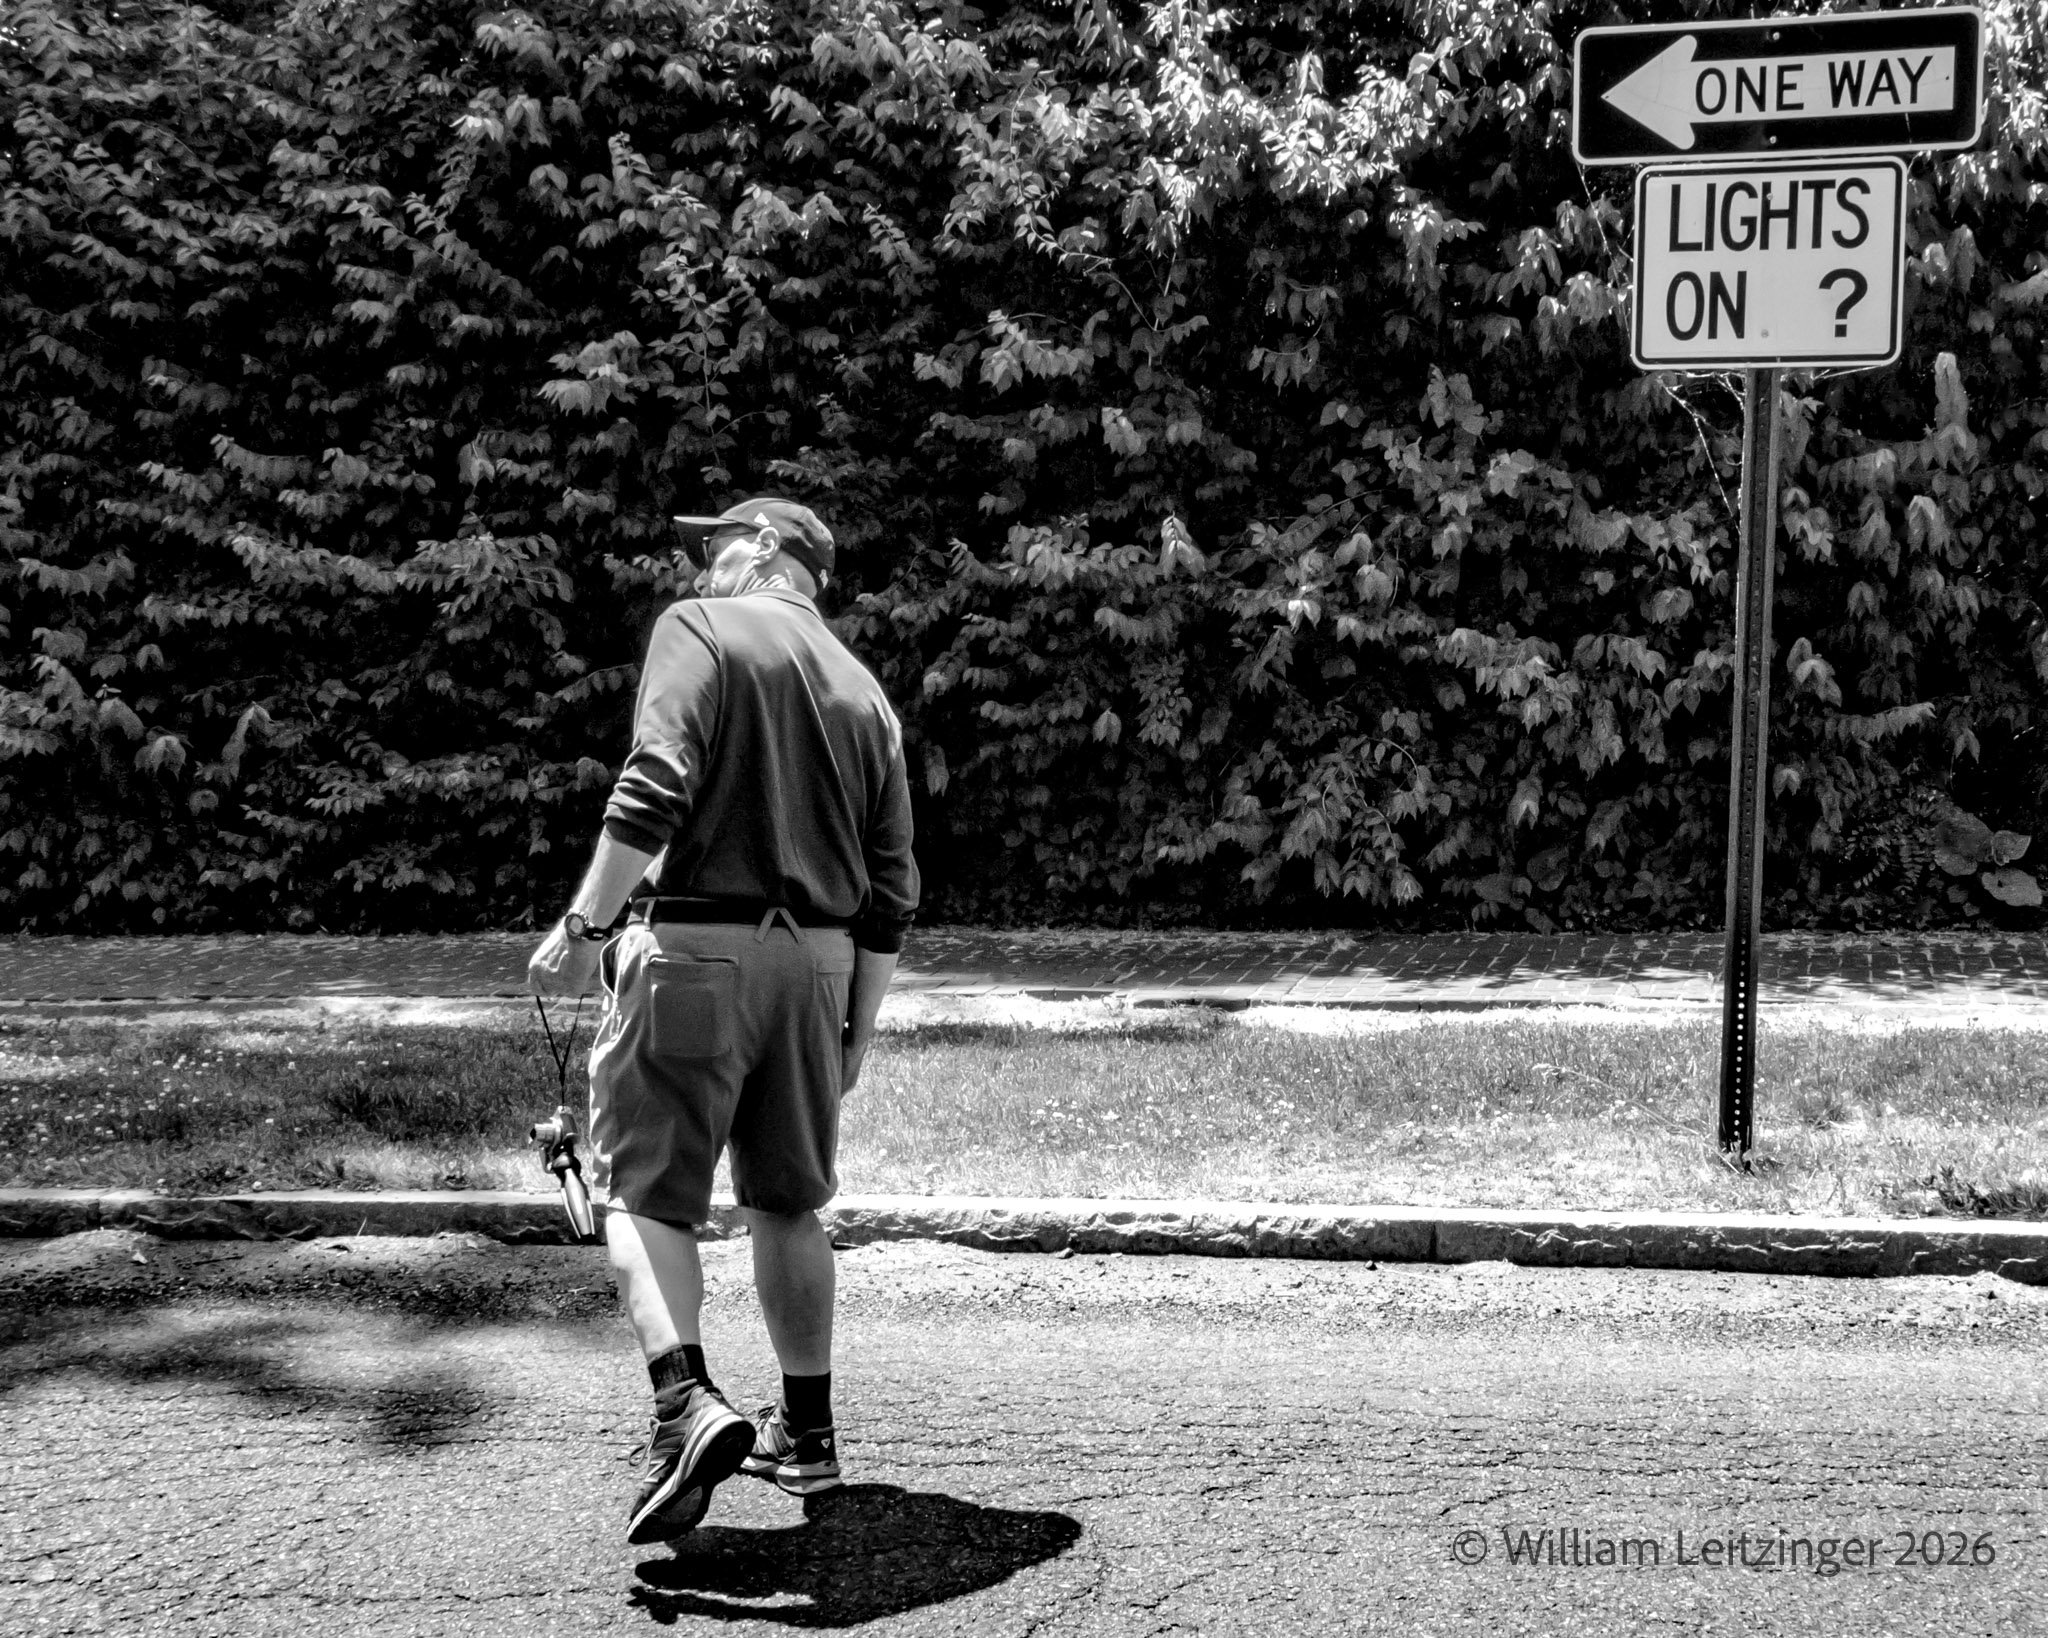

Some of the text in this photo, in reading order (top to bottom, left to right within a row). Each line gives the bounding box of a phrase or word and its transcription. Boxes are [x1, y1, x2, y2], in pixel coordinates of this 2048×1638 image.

[1695, 55, 1934, 116] ONE WAY
[1668, 177, 1872, 253] LIGHTS
[1665, 268, 1868, 341] ON ?
